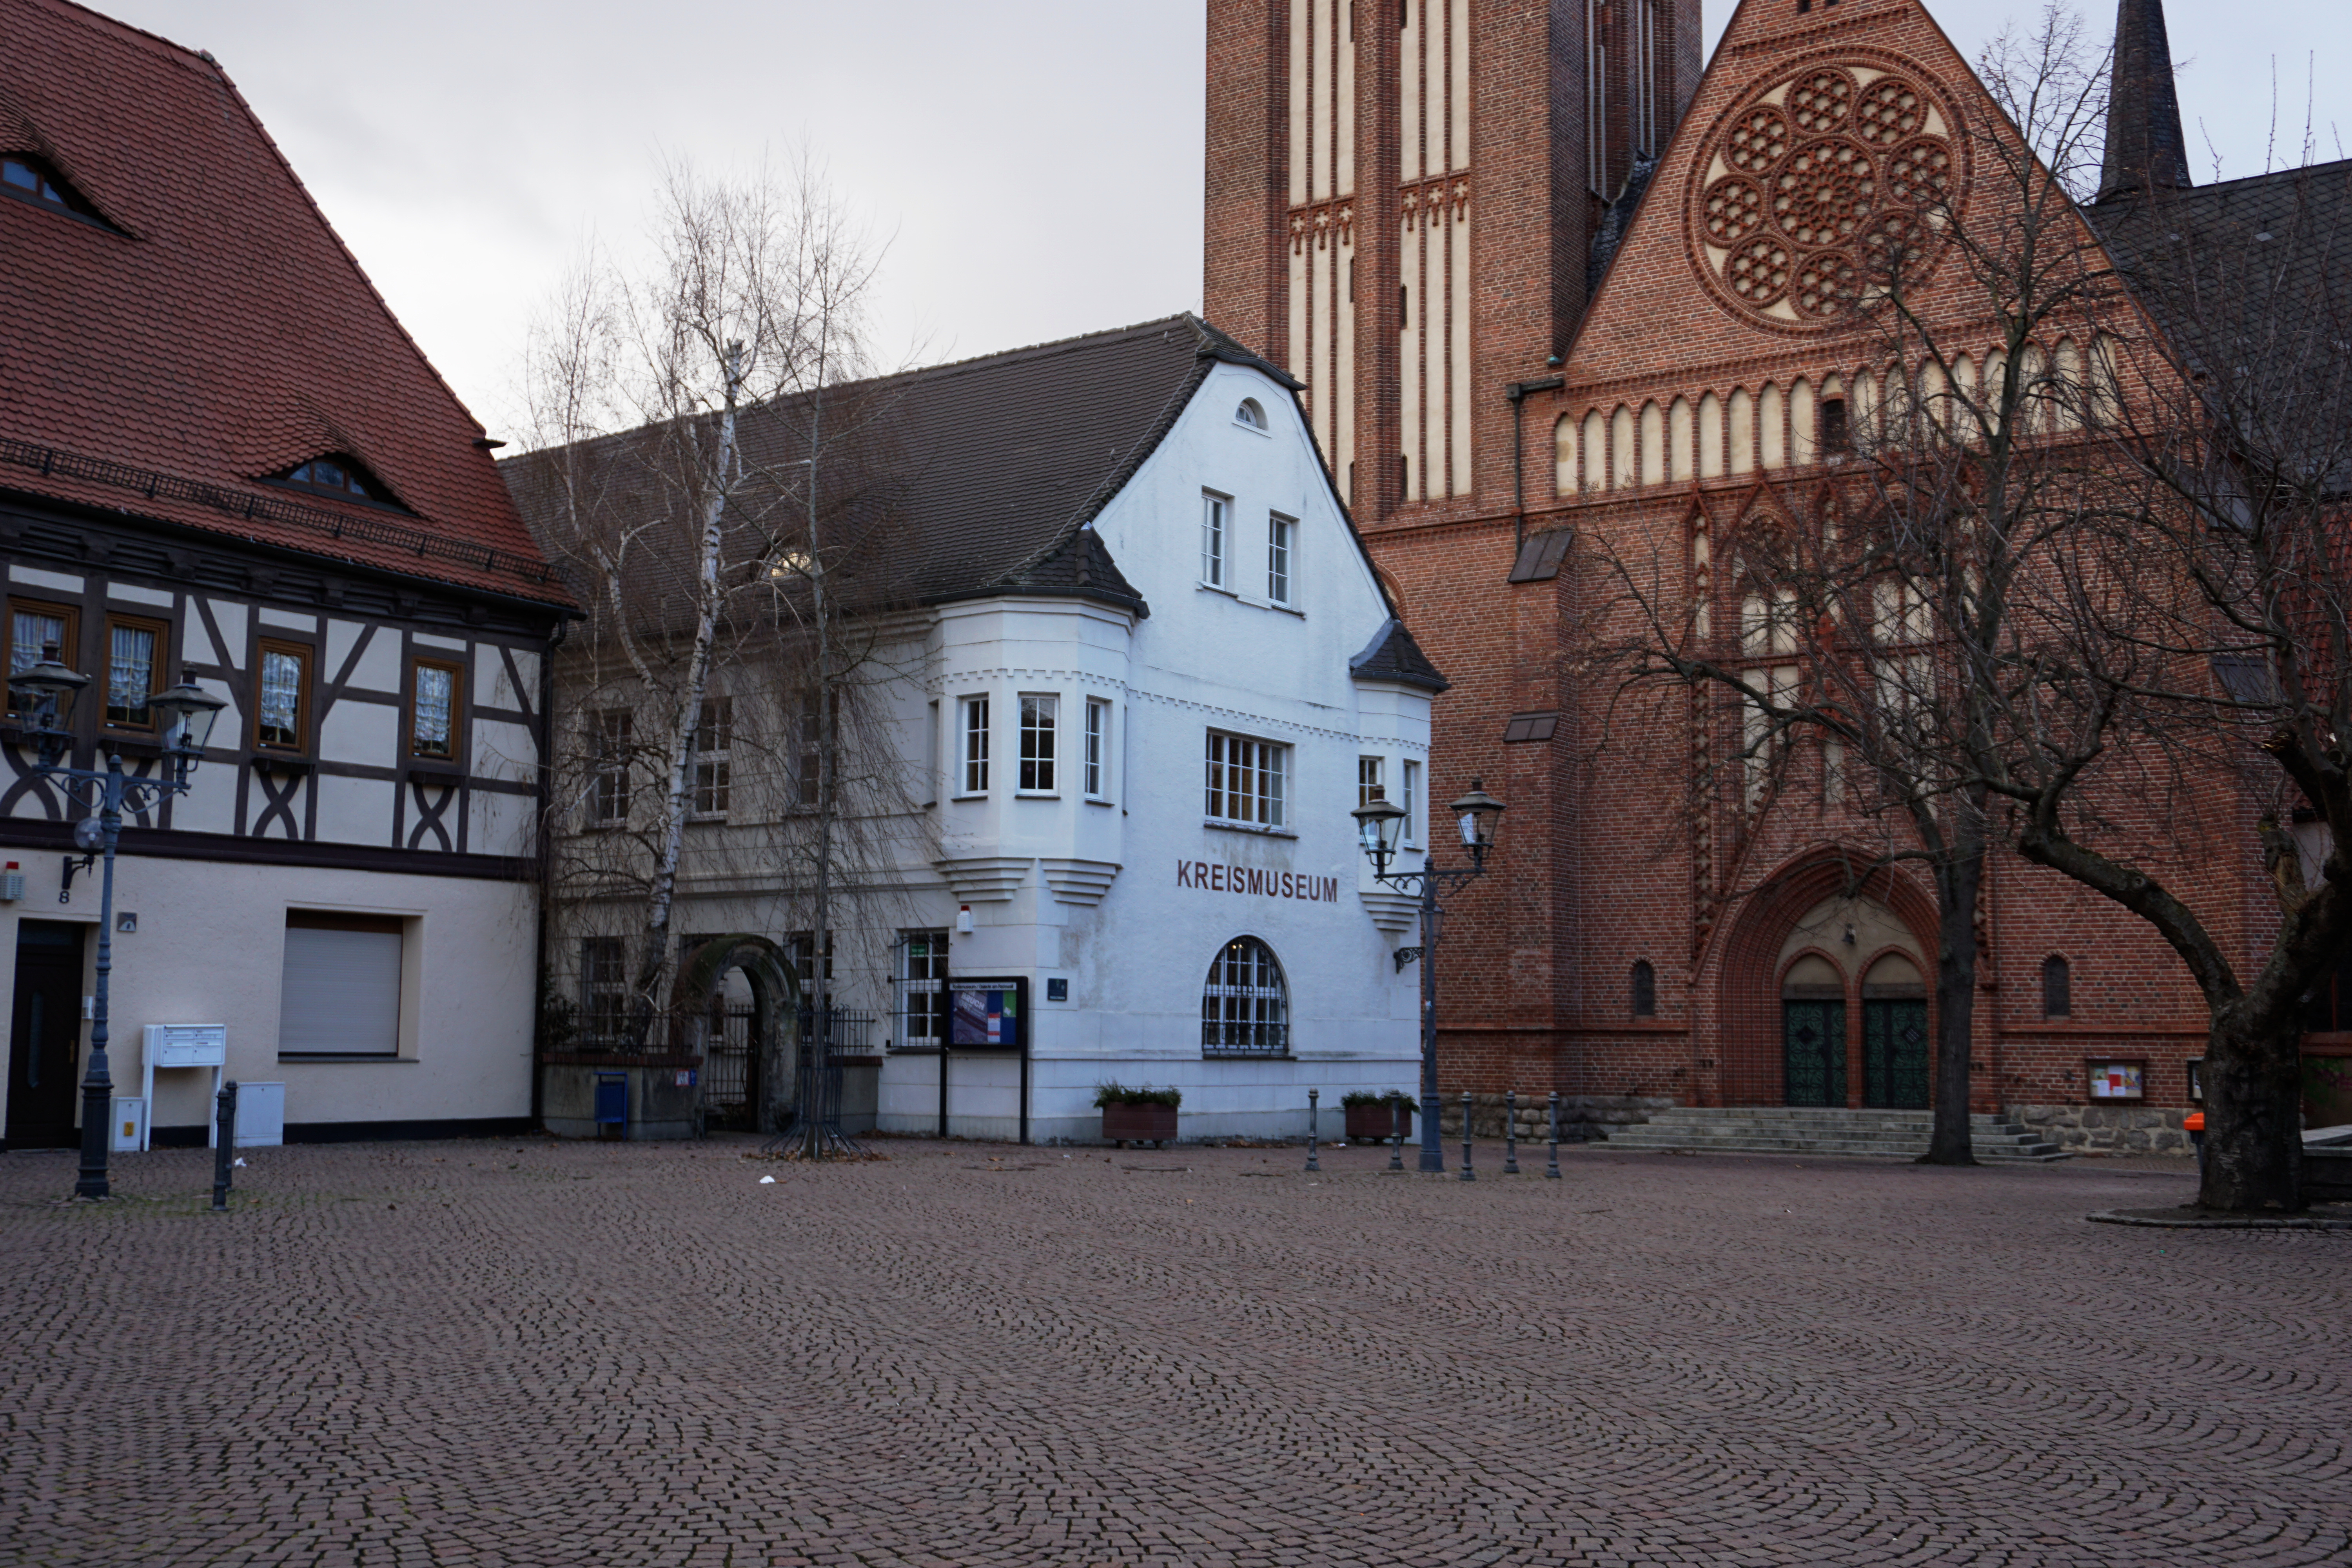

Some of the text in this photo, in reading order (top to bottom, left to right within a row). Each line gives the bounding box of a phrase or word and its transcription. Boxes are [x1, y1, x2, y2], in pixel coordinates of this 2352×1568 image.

[1178, 859, 1338, 902] KREISMUSEUM
[59, 890, 69, 904] 8
[961, 992, 985, 1010] BRUCH
